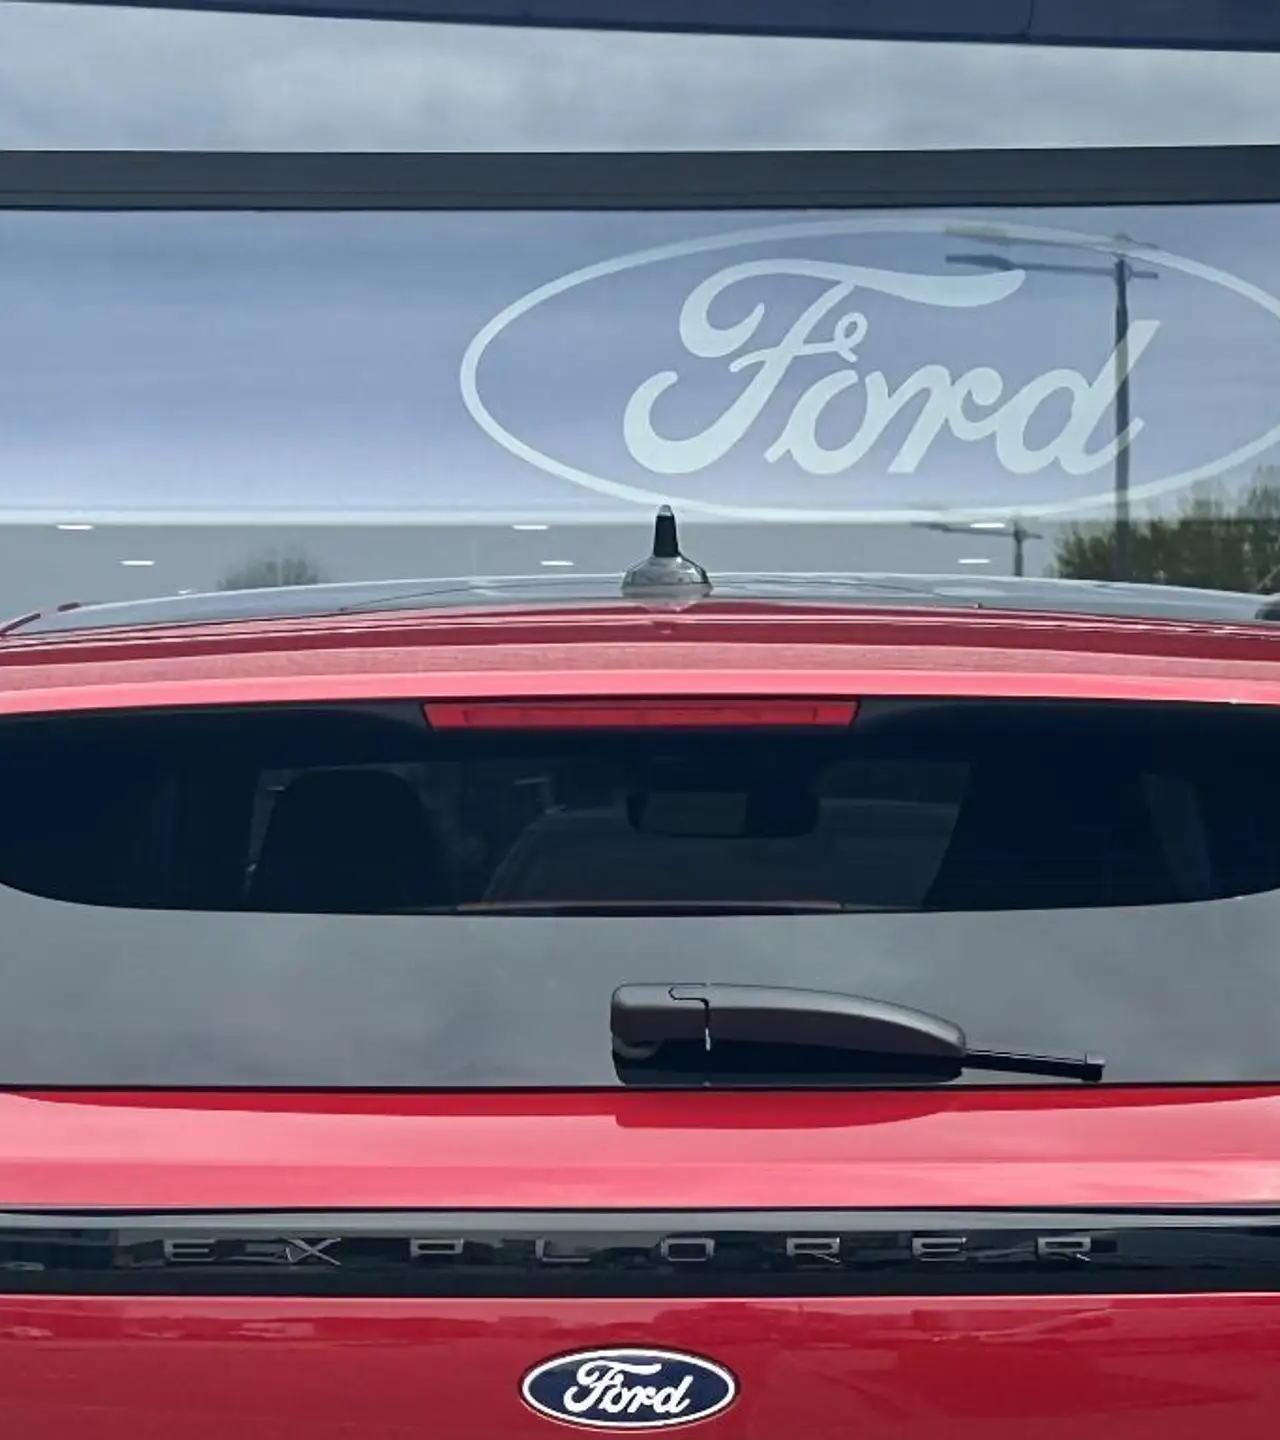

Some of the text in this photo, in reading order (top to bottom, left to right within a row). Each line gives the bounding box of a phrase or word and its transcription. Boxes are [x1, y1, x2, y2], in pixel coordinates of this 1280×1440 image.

[623, 257, 1160, 475] Ford
[163, 1236, 1092, 1265] EXPLORER
[563, 1360, 694, 1413] Ford
